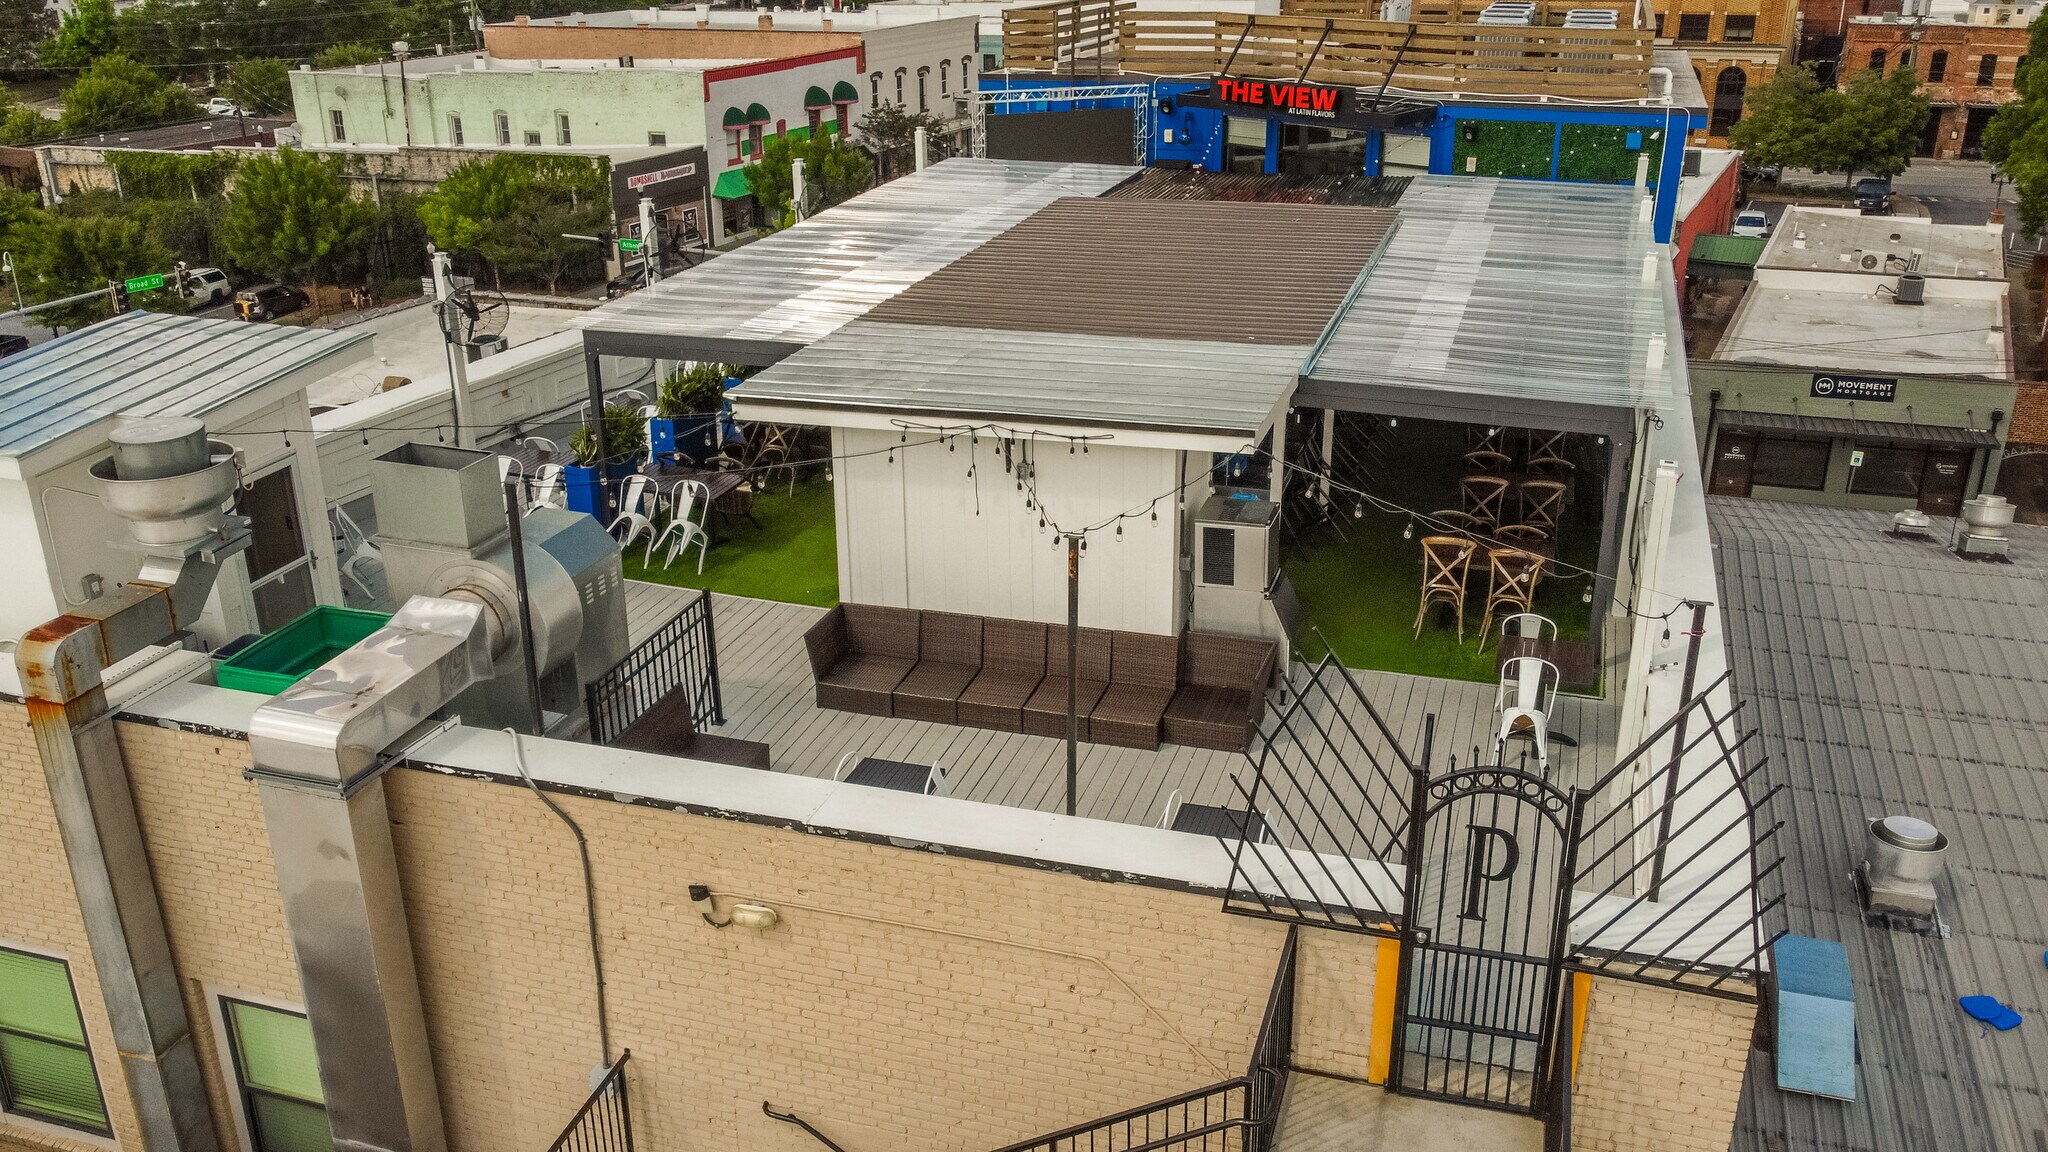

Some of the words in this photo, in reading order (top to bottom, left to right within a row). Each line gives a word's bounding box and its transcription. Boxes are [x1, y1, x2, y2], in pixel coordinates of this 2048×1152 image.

[1218, 80, 1264, 104] THE
[1270, 84, 1337, 111] VIEW
[1296, 108, 1311, 116] LATIN
[1312, 109, 1336, 118] FLAVORS
[128, 280, 148, 289] Broad
[1837, 381, 1893, 391] MOVEMENT
[1837, 389, 1892, 397] MORTGAGE
[1456, 824, 1520, 921] P
